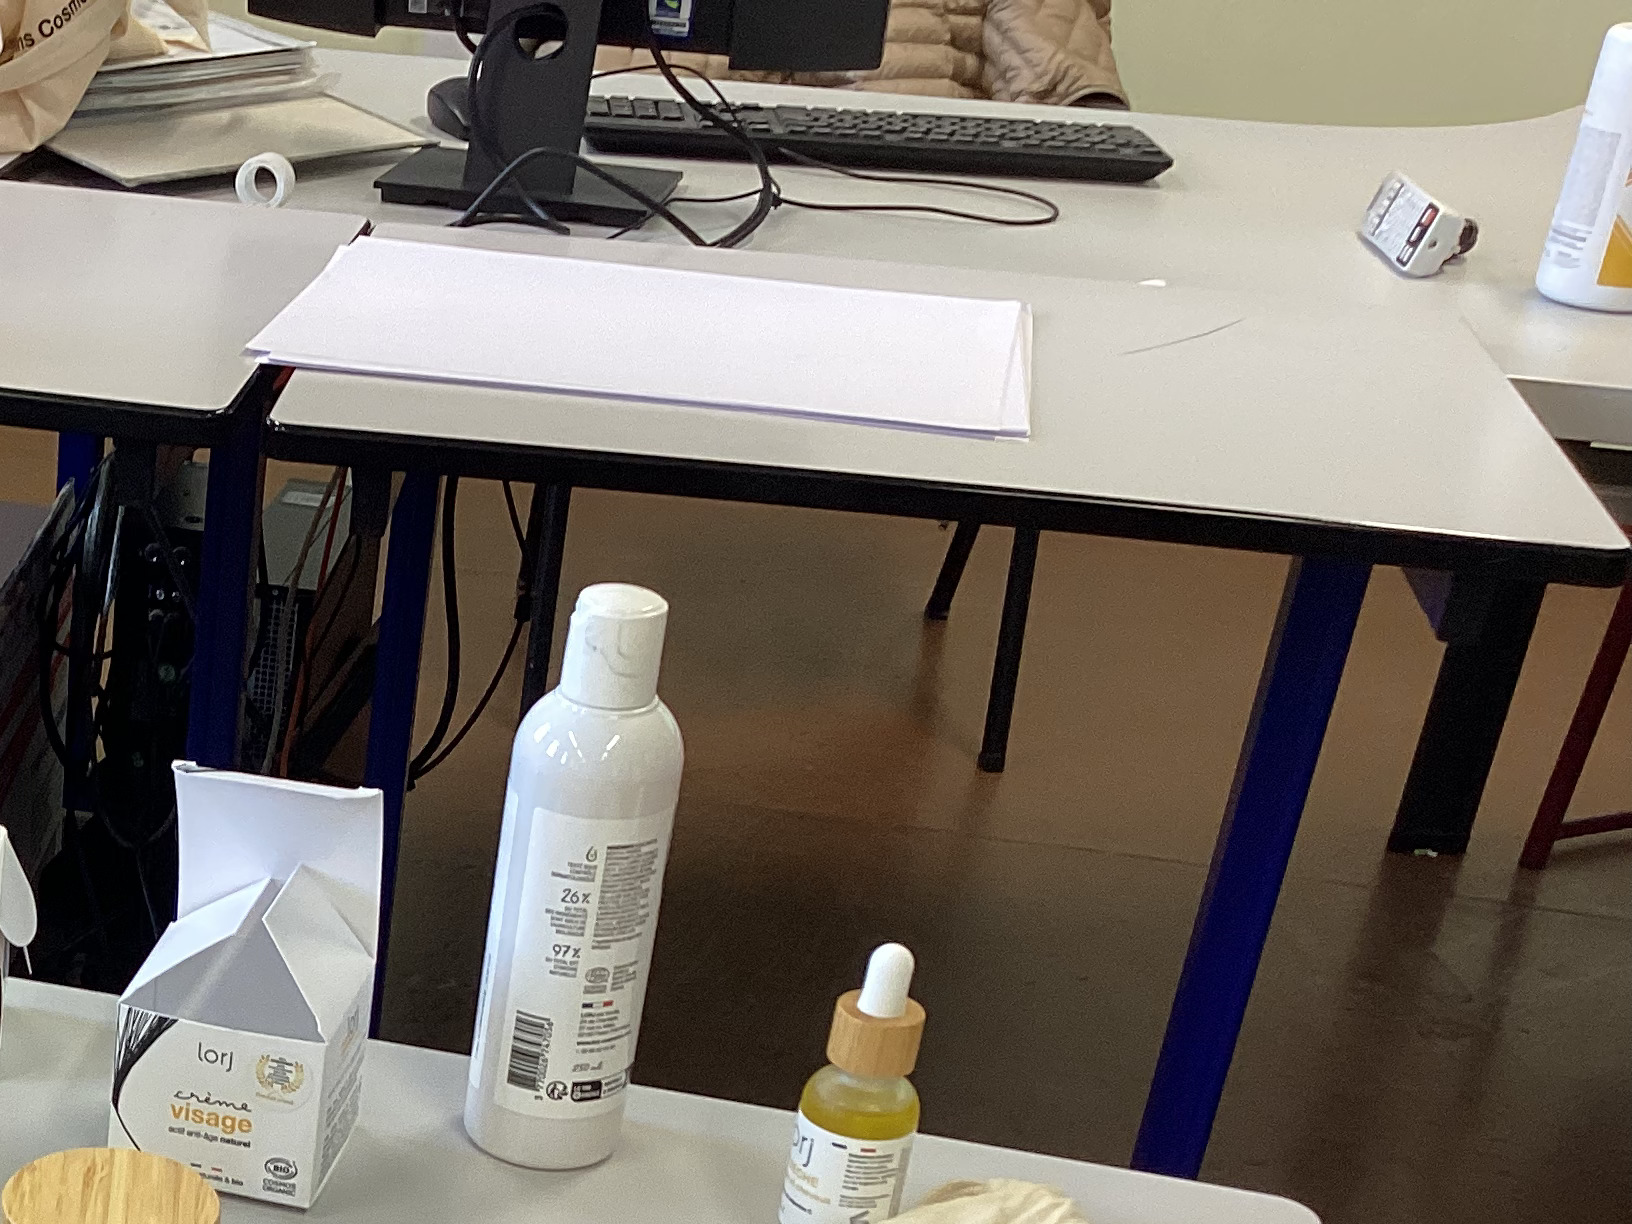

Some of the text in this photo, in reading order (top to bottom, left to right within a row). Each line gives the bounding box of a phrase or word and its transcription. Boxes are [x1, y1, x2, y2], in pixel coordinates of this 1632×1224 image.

[197, 1041, 234, 1073] lorj
[173, 1089, 253, 1113] crème
[170, 1102, 253, 1135] visage
[273, 1164, 290, 1174] BIO
